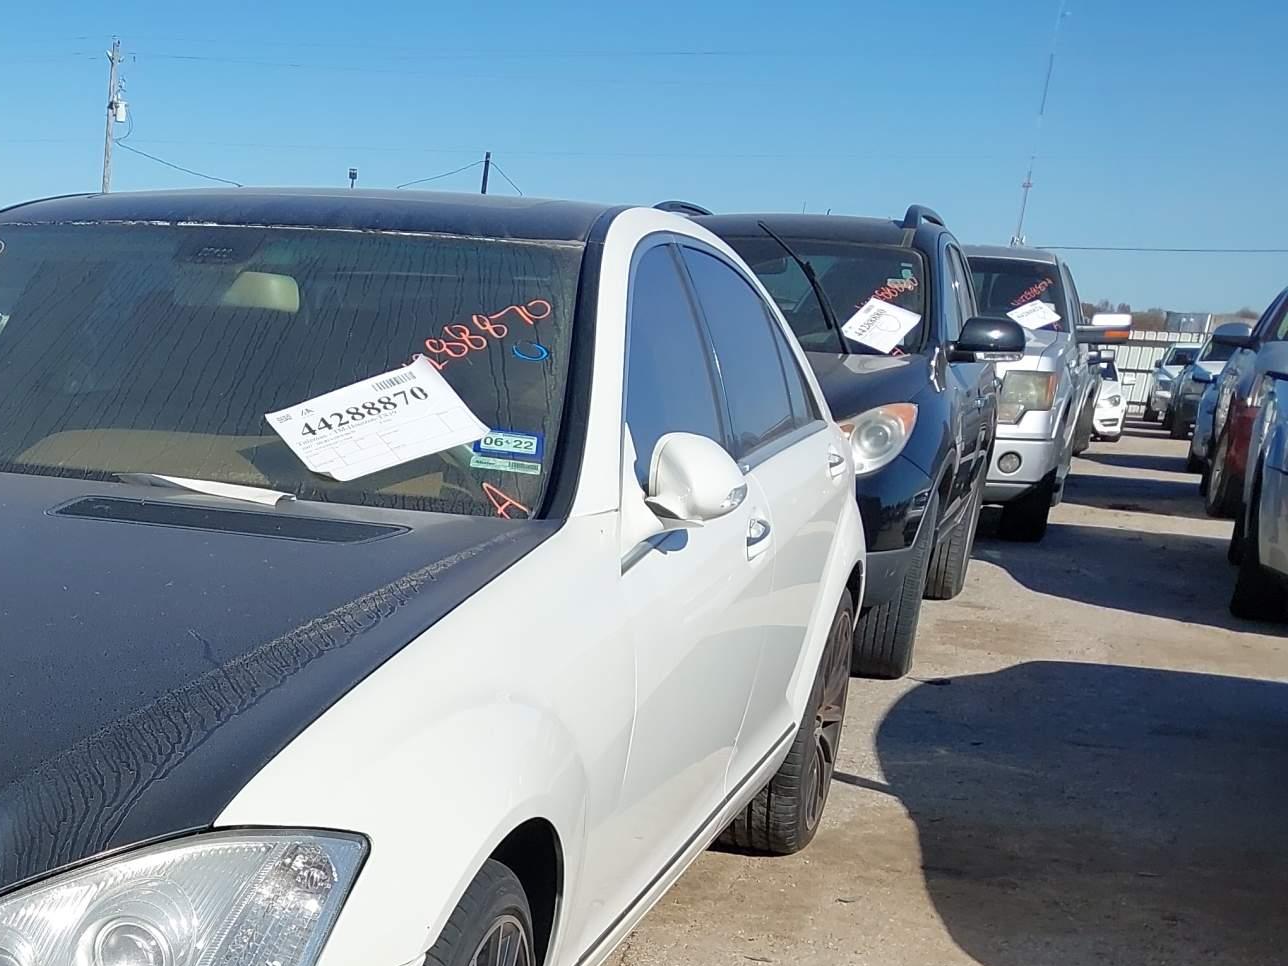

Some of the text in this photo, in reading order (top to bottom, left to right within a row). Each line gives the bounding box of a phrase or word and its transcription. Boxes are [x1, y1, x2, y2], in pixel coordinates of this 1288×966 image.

[300, 385, 430, 437] 44288870
[483, 436, 534, 450] 06 22
